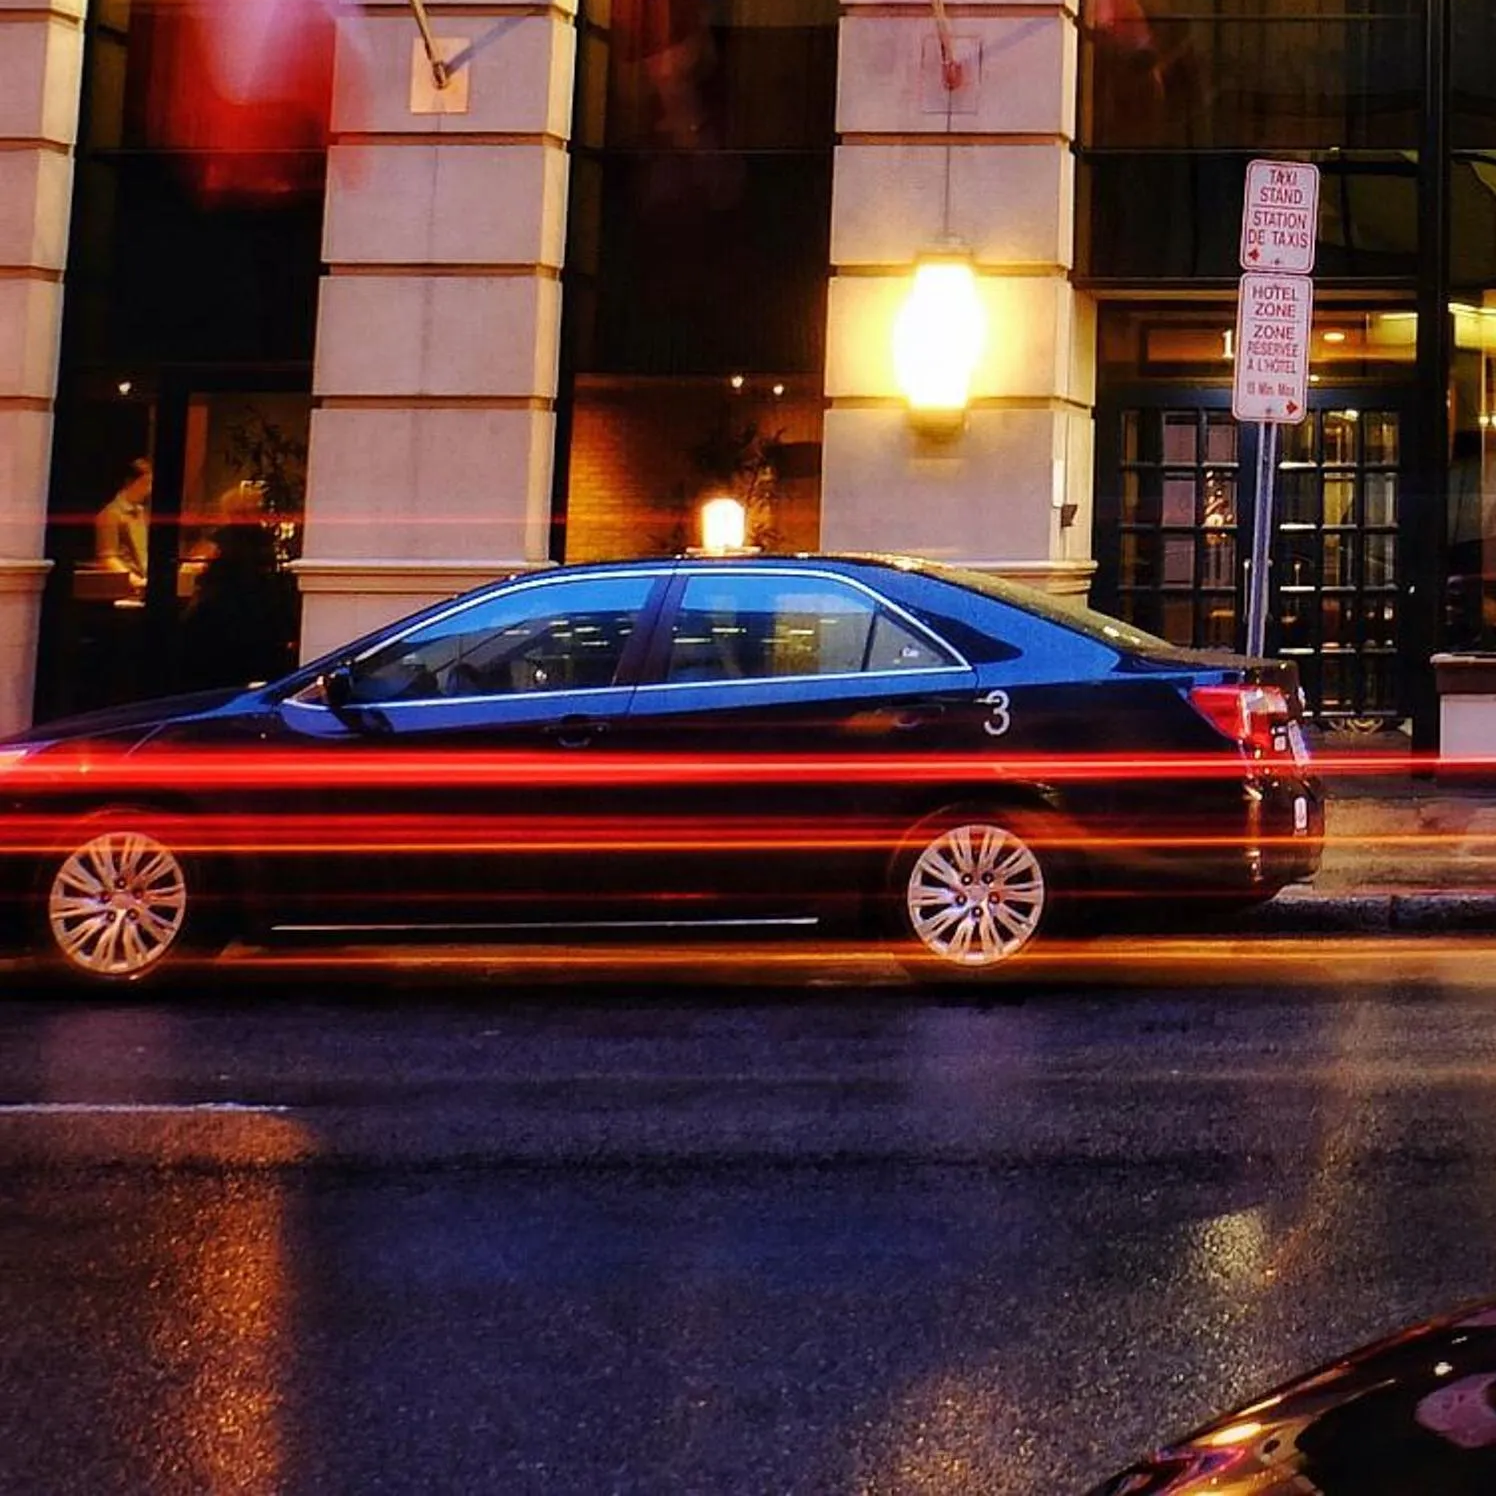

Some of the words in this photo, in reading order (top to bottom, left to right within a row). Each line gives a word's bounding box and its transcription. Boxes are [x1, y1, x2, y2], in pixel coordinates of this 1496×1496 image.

[1269, 169, 1298, 186] TAXI
[1259, 186, 1303, 205] STAND
[1252, 210, 1308, 230] STATION
[1247, 228, 1266, 246] DE
[1272, 230, 1309, 249] TAXIS
[1251, 284, 1299, 302] HOTEL
[1254, 302, 1297, 318] ZONE
[1252, 323, 1295, 340] ZONE
[983, 689, 1012, 737] 3
